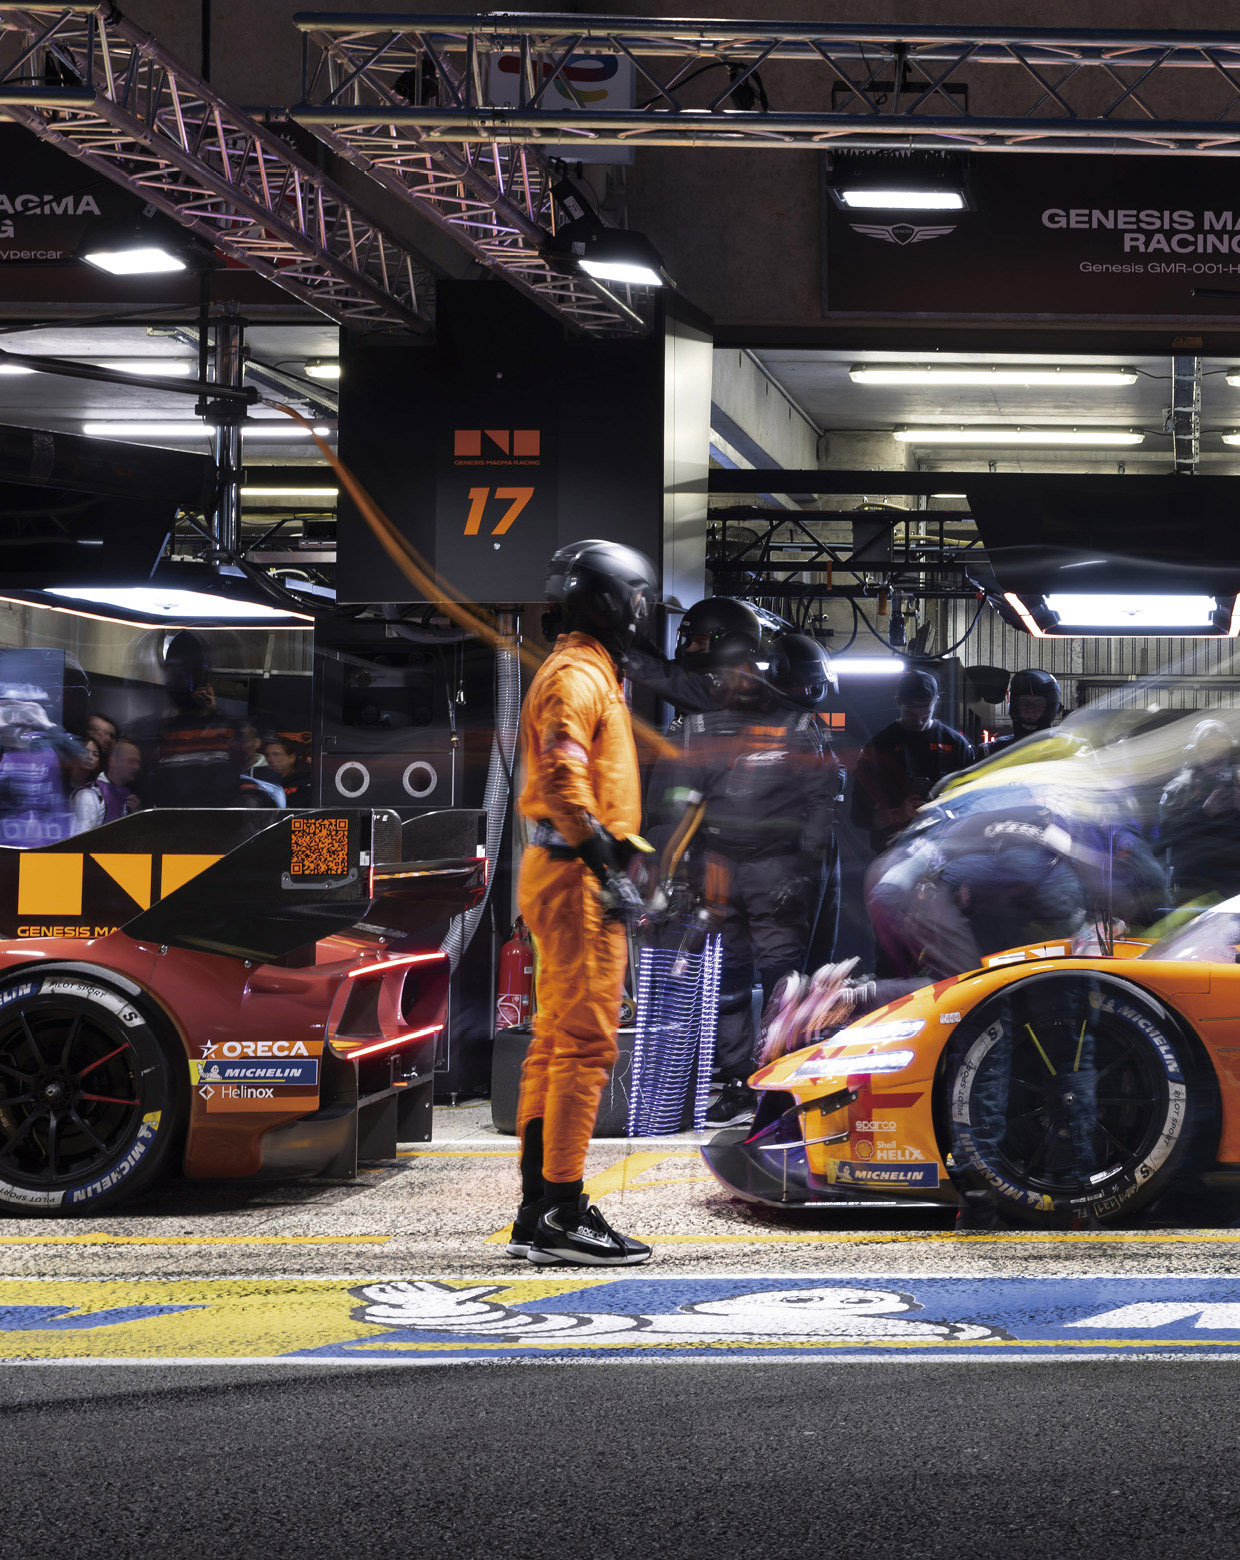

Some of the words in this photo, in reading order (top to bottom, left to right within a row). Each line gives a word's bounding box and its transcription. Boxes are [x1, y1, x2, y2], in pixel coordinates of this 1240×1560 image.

[1041, 208, 1195, 230] GENESIS
[1079, 261, 1144, 273] Genesis
[463, 487, 535, 535] 17
[17, 926, 90, 937] GENESIS
[49, 981, 75, 989] PILOT
[77, 984, 106, 998] SPORT
[1117, 1004, 1180, 1076] MICHELIN
[222, 1040, 309, 1057] ORECA
[224, 1068, 303, 1078] MICHELIN
[960, 1058, 975, 1089] SPORT
[221, 1085, 275, 1099] Helinox
[957, 1090, 966, 1116] PILOT
[855, 1120, 897, 1132] sparco
[876, 1141, 897, 1149] Shell
[876, 1146, 926, 1160] HELIX
[73, 1141, 146, 1203] MICHELIN
[854, 1170, 924, 1180] MICHELIN
